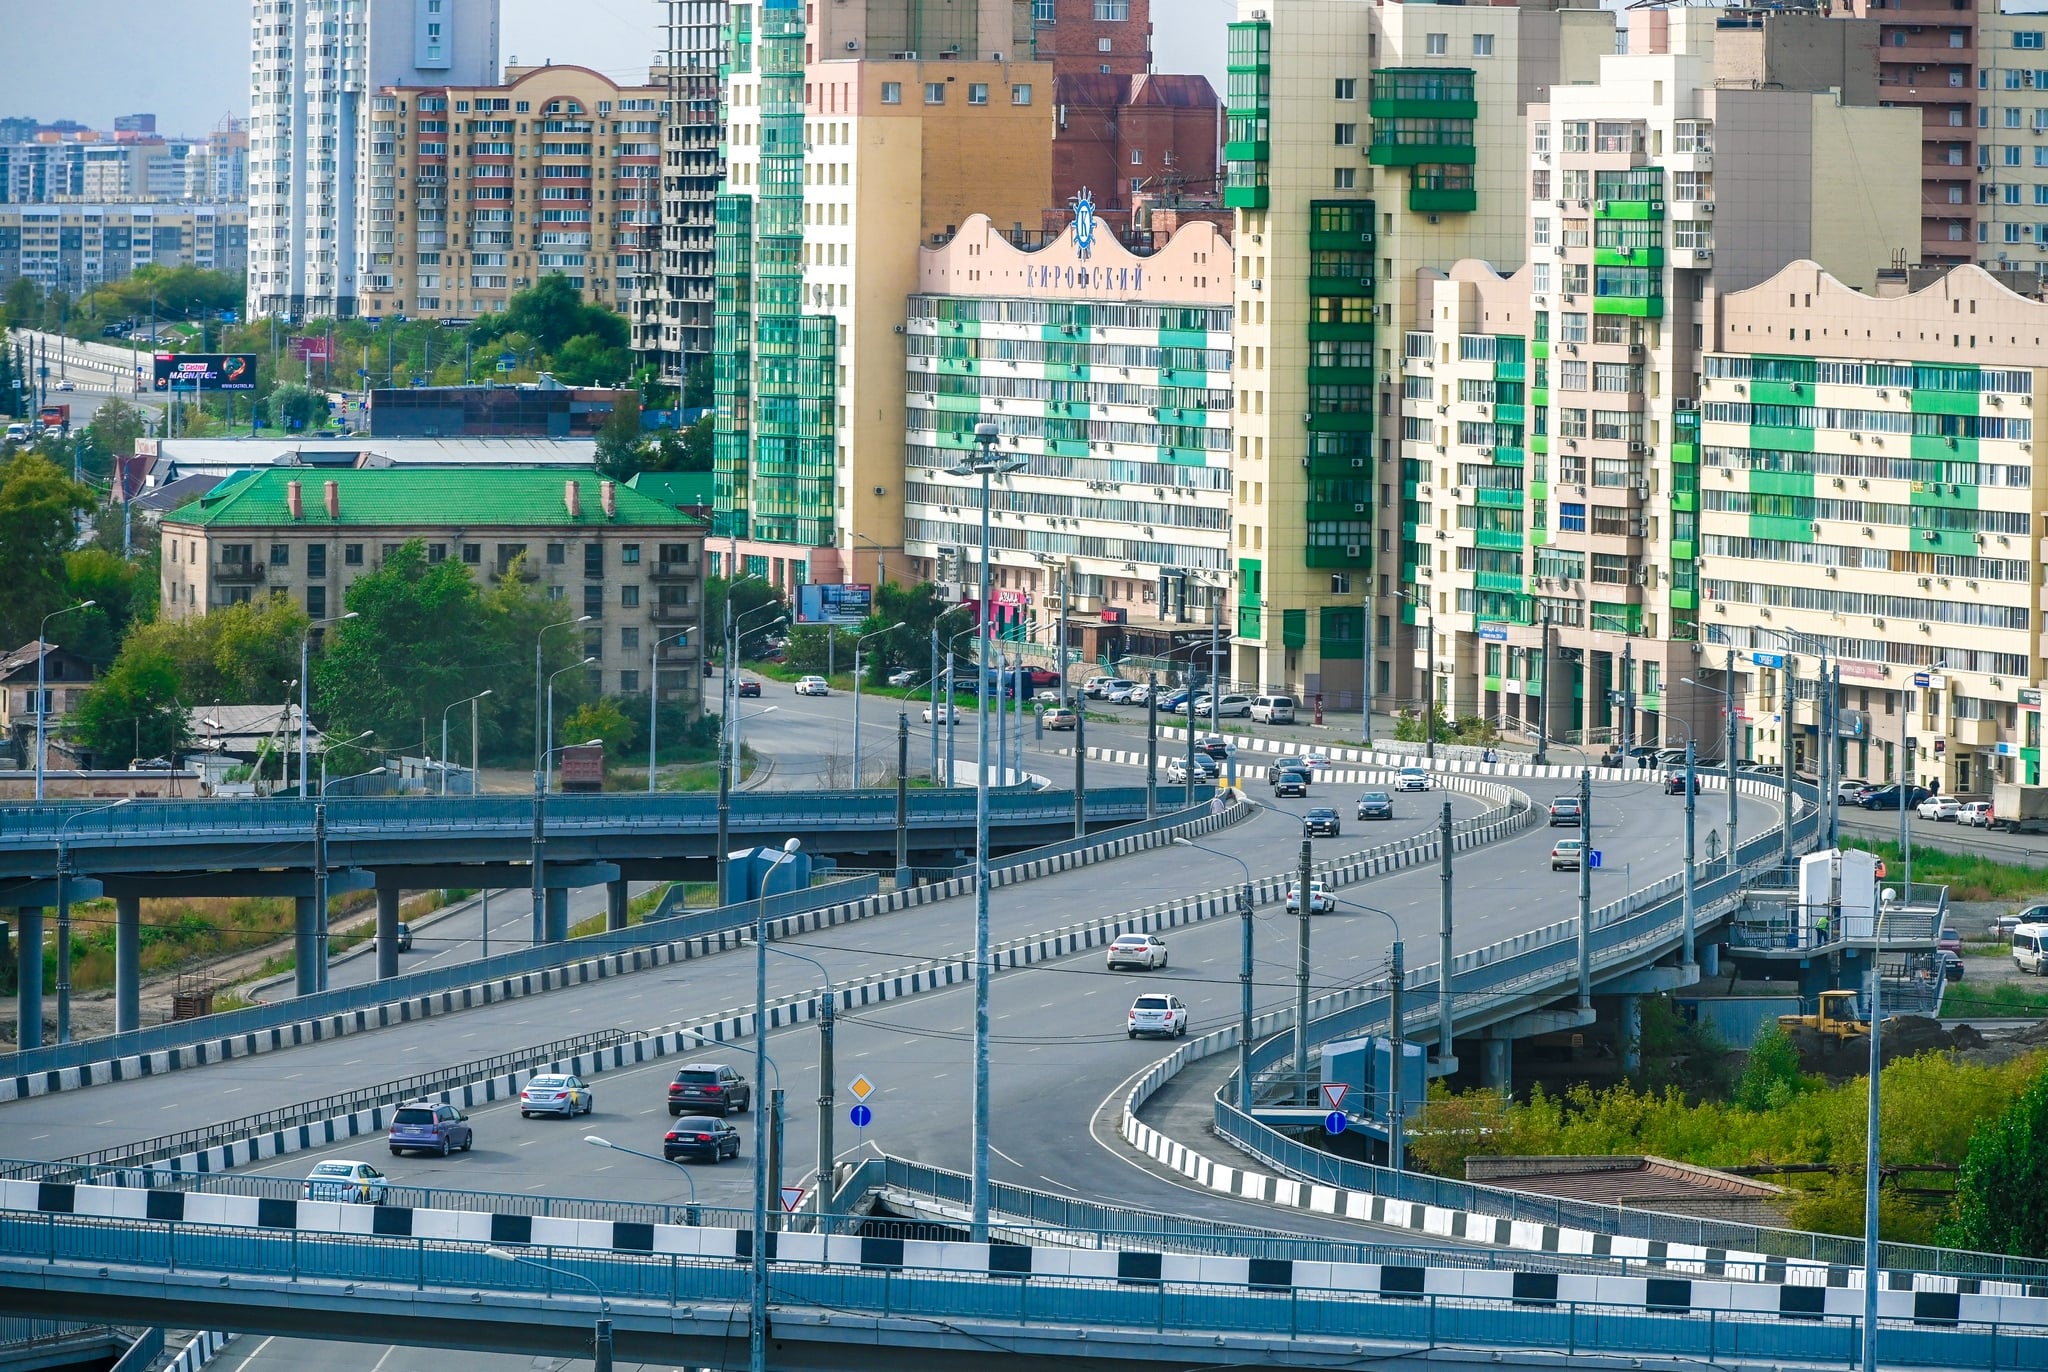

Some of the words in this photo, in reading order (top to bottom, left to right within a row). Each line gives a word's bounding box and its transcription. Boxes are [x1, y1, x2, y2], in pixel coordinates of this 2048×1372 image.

[1027, 263, 1142, 291] КИРОВСКИЙ
[185, 363, 206, 371] Castrol
[169, 371, 218, 379] MAGNATEC
